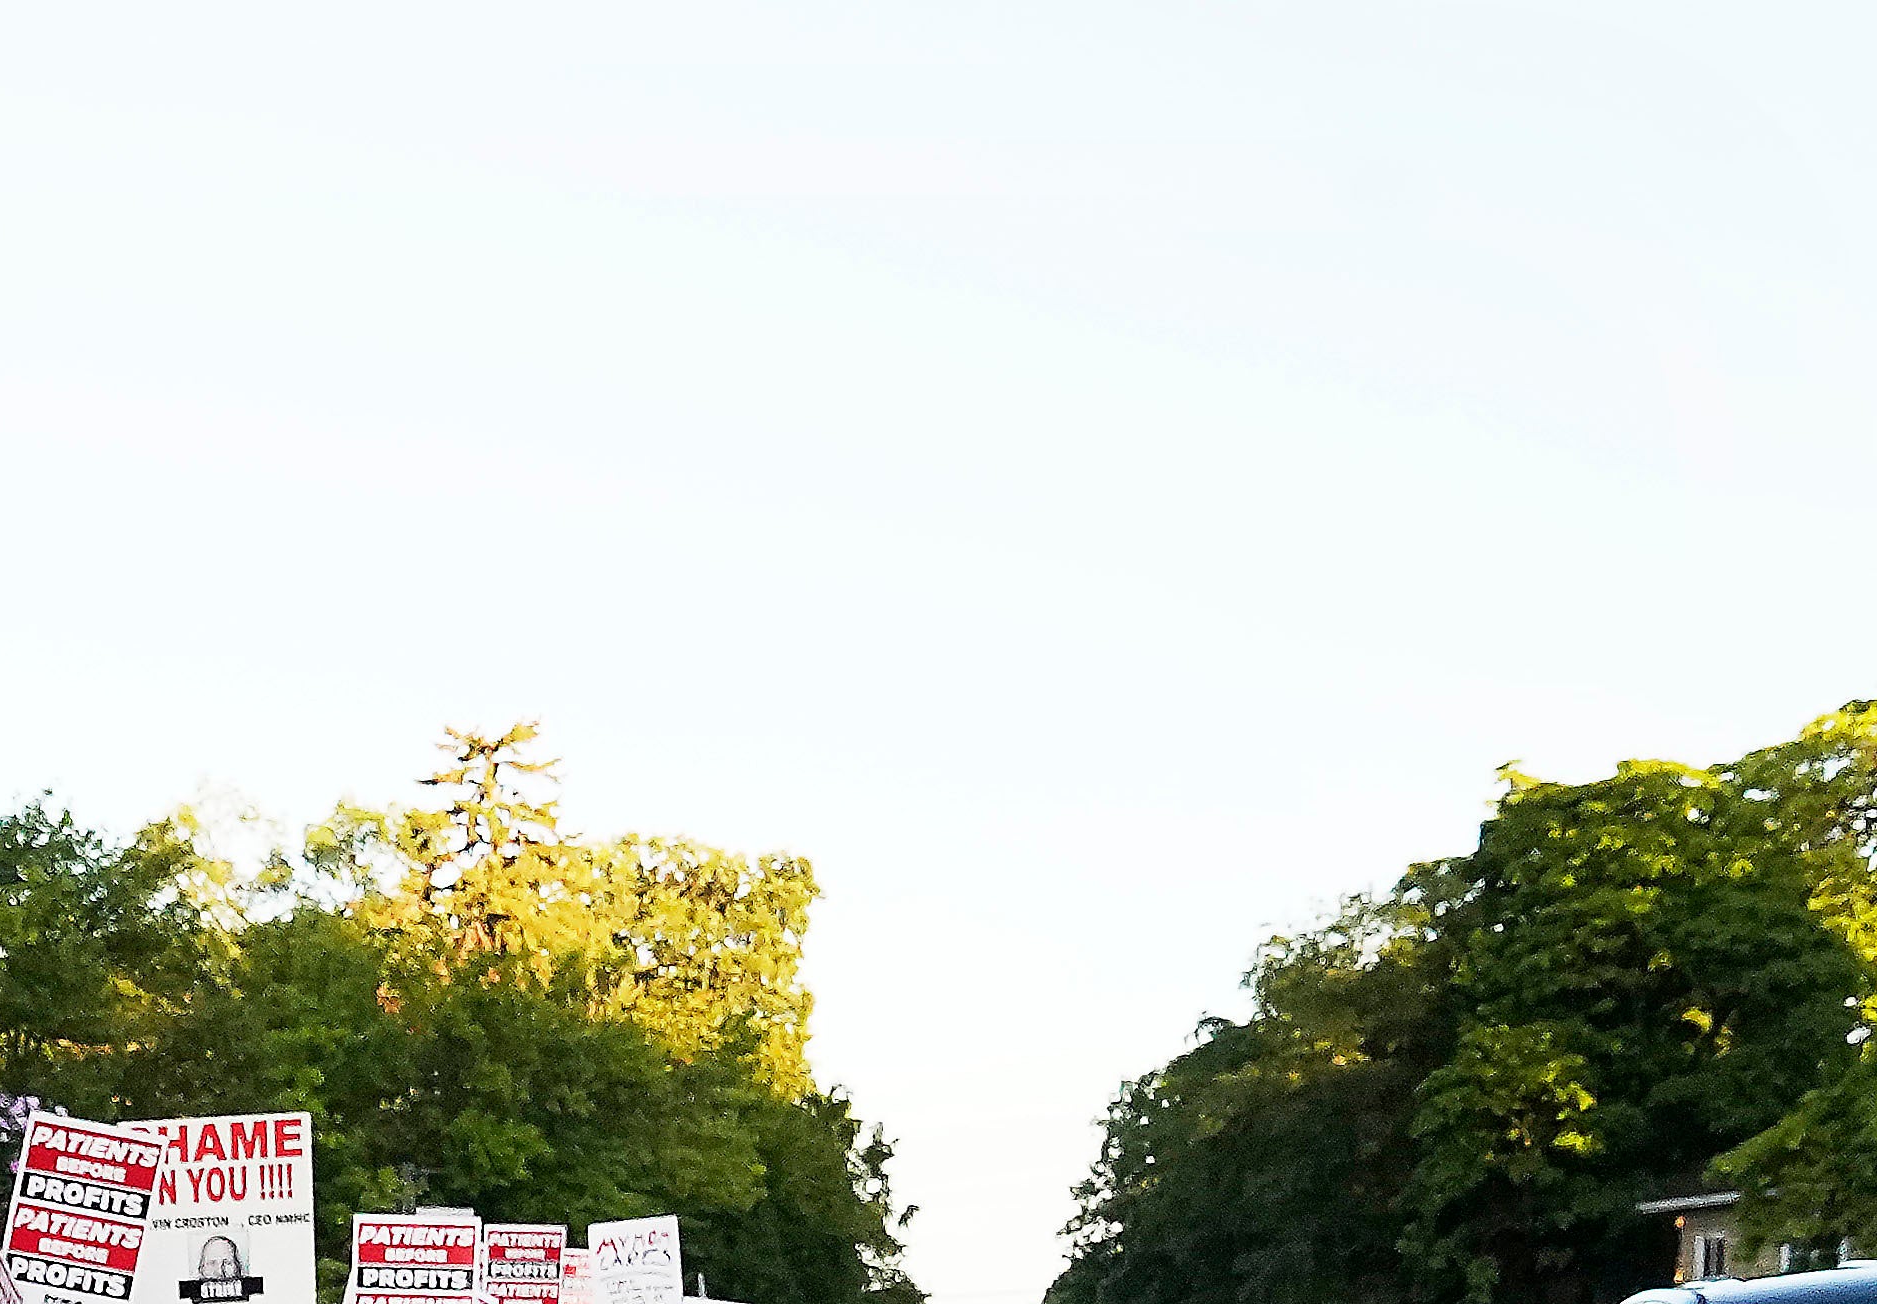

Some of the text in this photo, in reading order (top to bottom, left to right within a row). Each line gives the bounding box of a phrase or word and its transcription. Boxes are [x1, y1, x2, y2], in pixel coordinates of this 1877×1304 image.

[31, 1125, 161, 1169] PATIENTS
[132, 1118, 303, 1163] HAME
[26, 1175, 144, 1217] PROFITS
[187, 1165, 247, 1204] YOU
[13, 1207, 144, 1250] PATIENTS
[359, 1225, 475, 1248] PATIENTS
[10, 1256, 126, 1298] PROFITS
[362, 1268, 469, 1290] PROFITS
